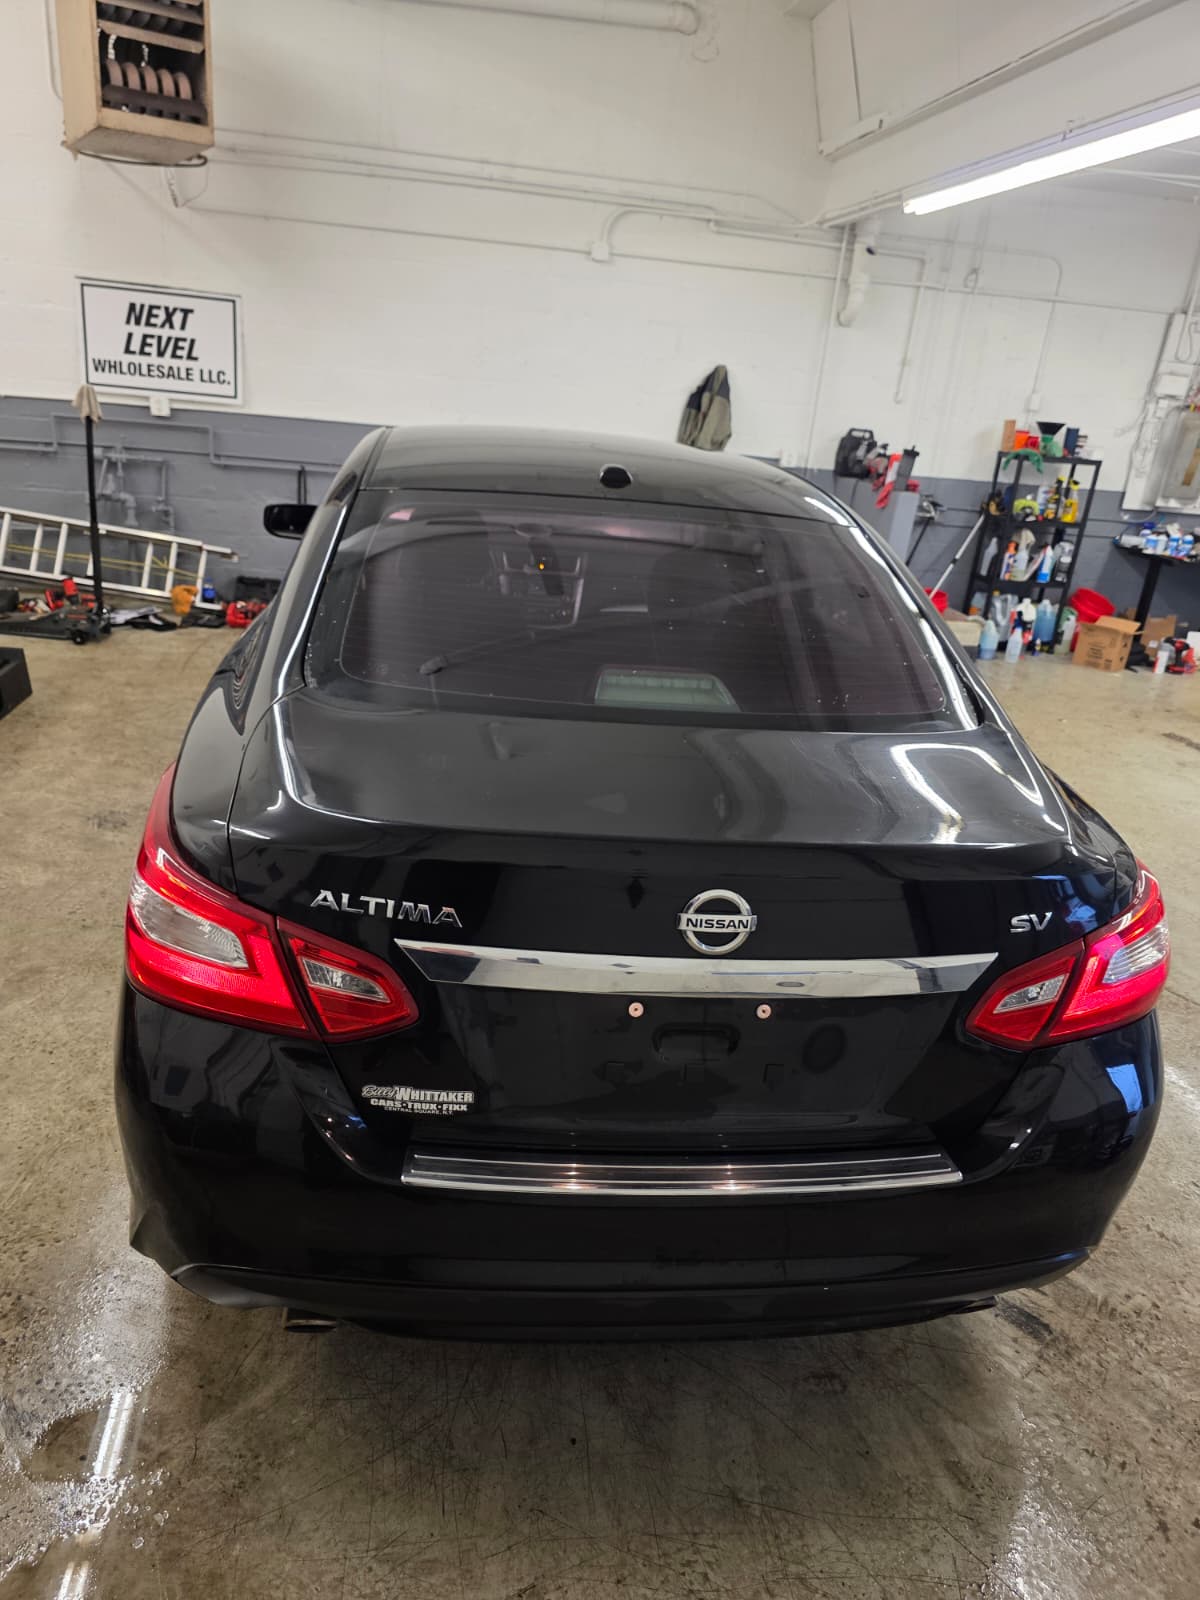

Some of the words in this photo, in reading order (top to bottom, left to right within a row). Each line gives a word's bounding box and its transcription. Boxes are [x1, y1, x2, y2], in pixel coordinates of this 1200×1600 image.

[125, 302, 194, 331] NEXT
[123, 332, 199, 361] LEVEL
[92, 358, 194, 382] WHLOLESALE
[199, 368, 231, 385] LLC.
[310, 889, 463, 928] ALTIMA
[1010, 911, 1053, 933] SV
[686, 917, 749, 929] NISSAN
[395, 1086, 474, 1103] WHITTAKER
